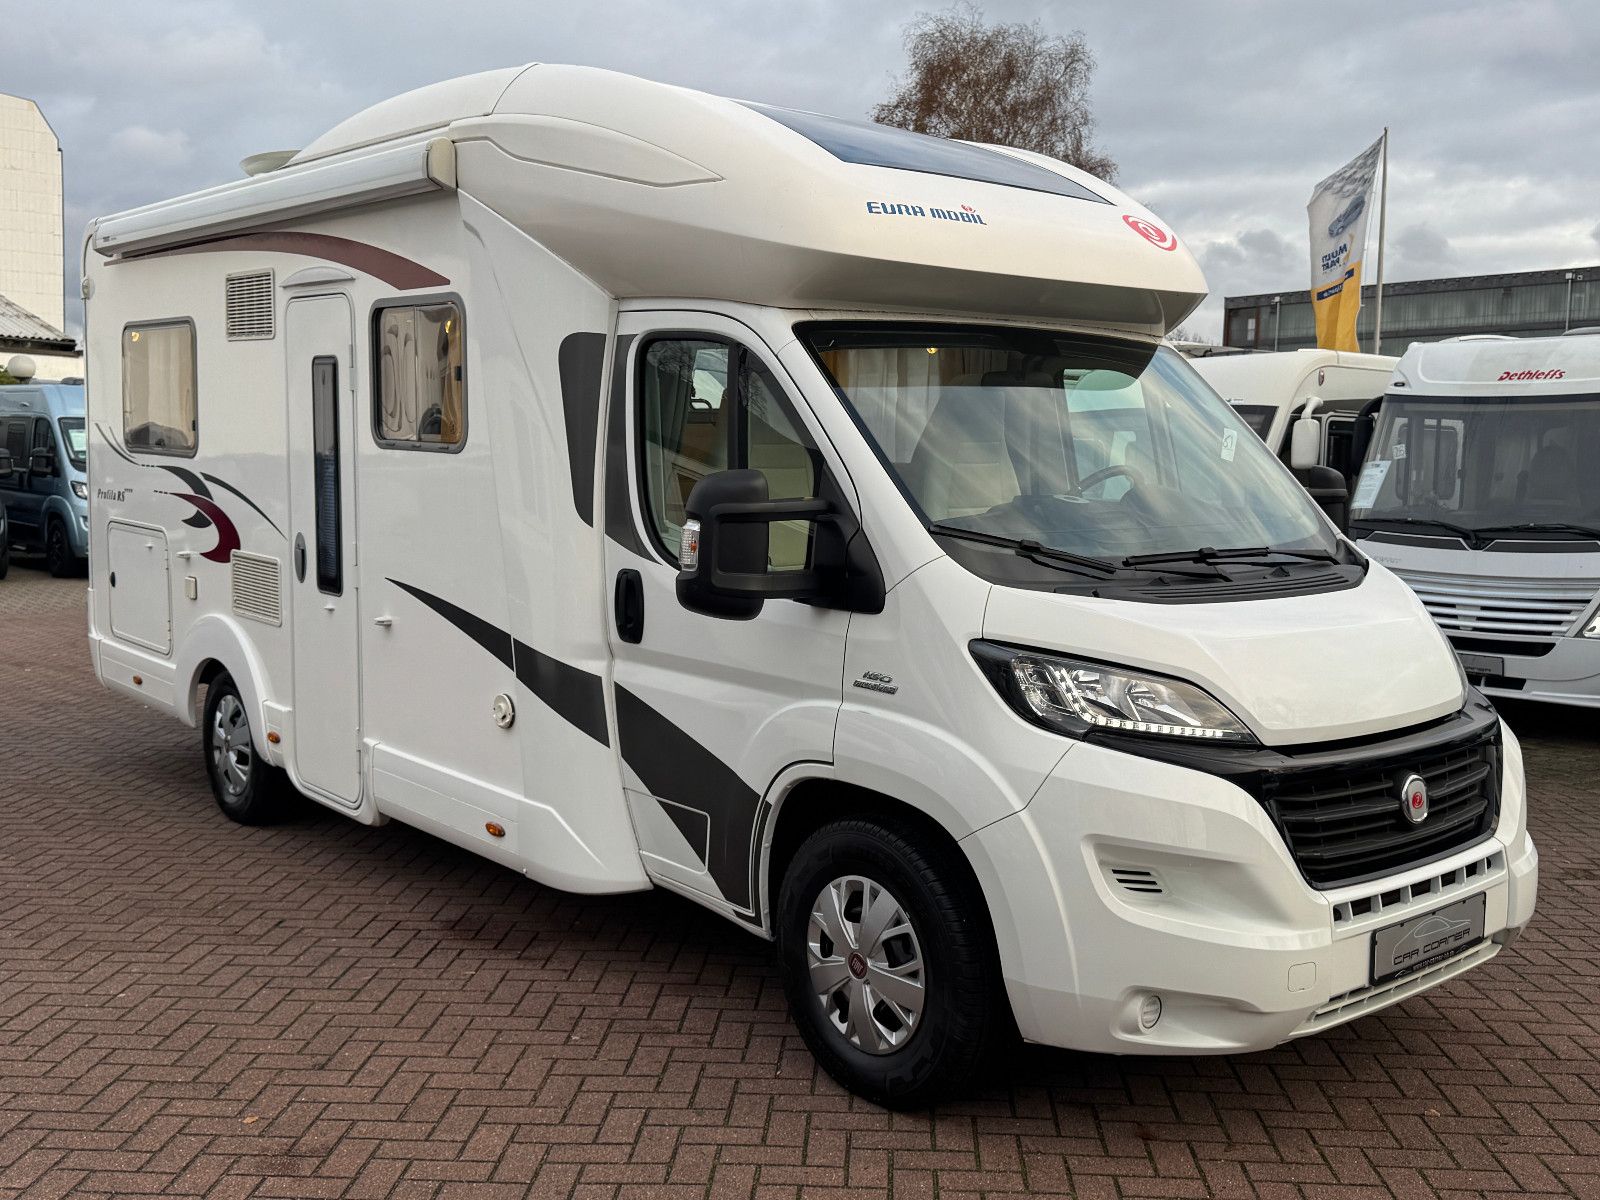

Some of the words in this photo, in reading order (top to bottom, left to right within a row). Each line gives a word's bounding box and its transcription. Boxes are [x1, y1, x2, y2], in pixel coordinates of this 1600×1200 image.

[1497, 369, 1566, 382] Dethleffs
[1393, 948, 1420, 966] CAR
[1423, 928, 1471, 954] CORNER
